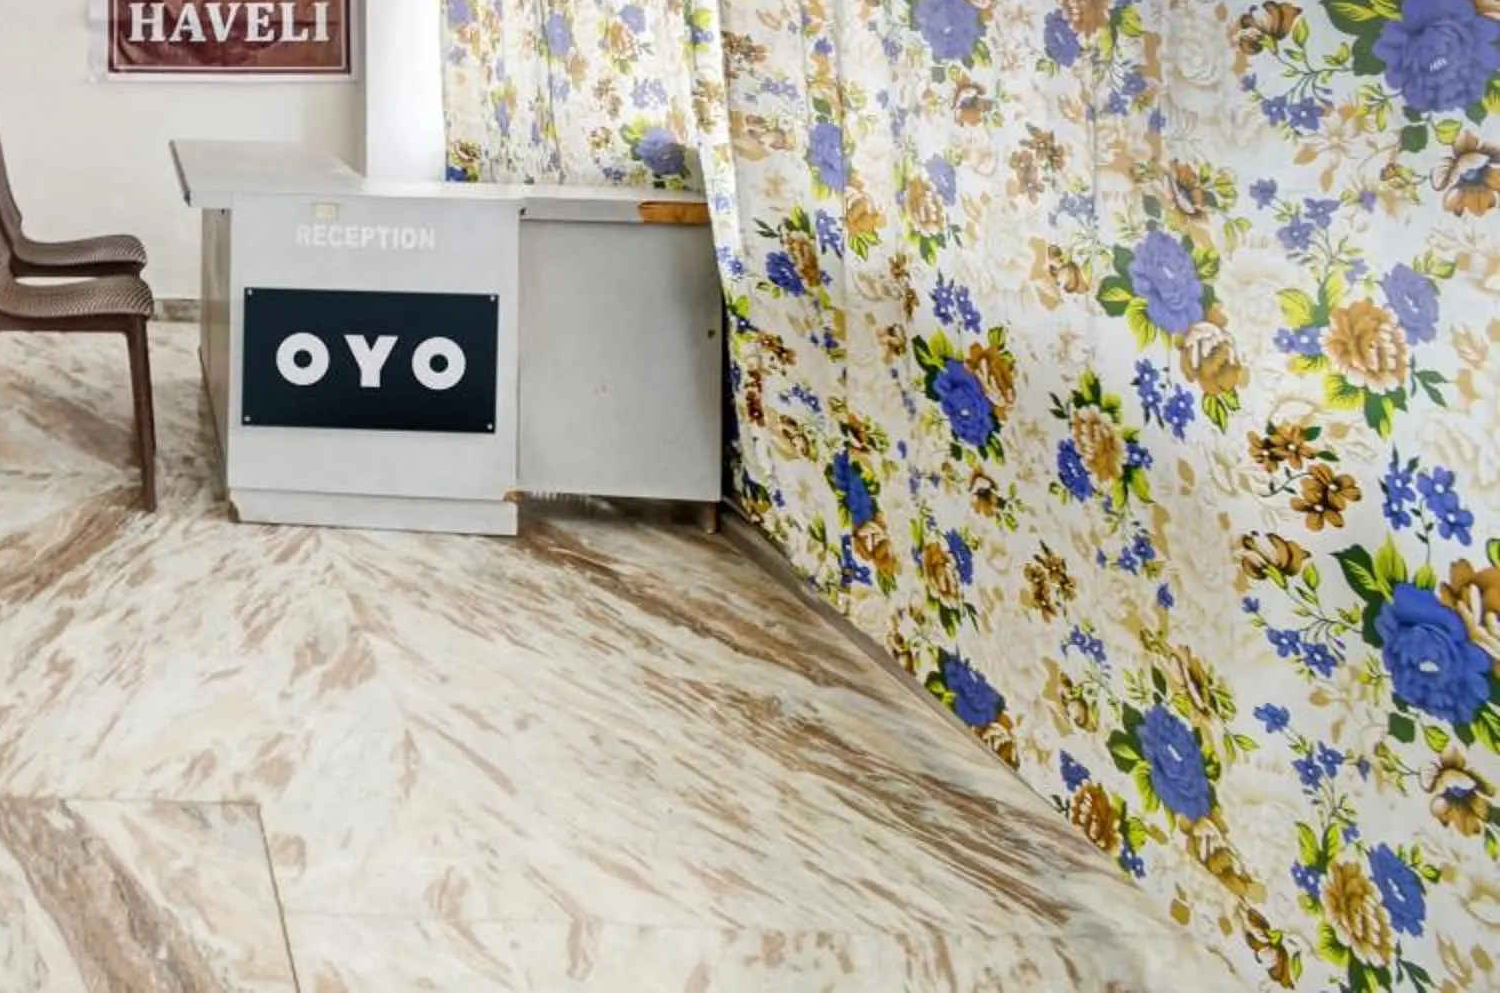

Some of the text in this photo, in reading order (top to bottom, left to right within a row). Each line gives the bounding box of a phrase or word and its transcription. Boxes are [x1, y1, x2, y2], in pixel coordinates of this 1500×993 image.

[128, 1, 330, 43] HAVELI
[296, 222, 436, 250] RECEPTION
[275, 331, 467, 391] OYO
